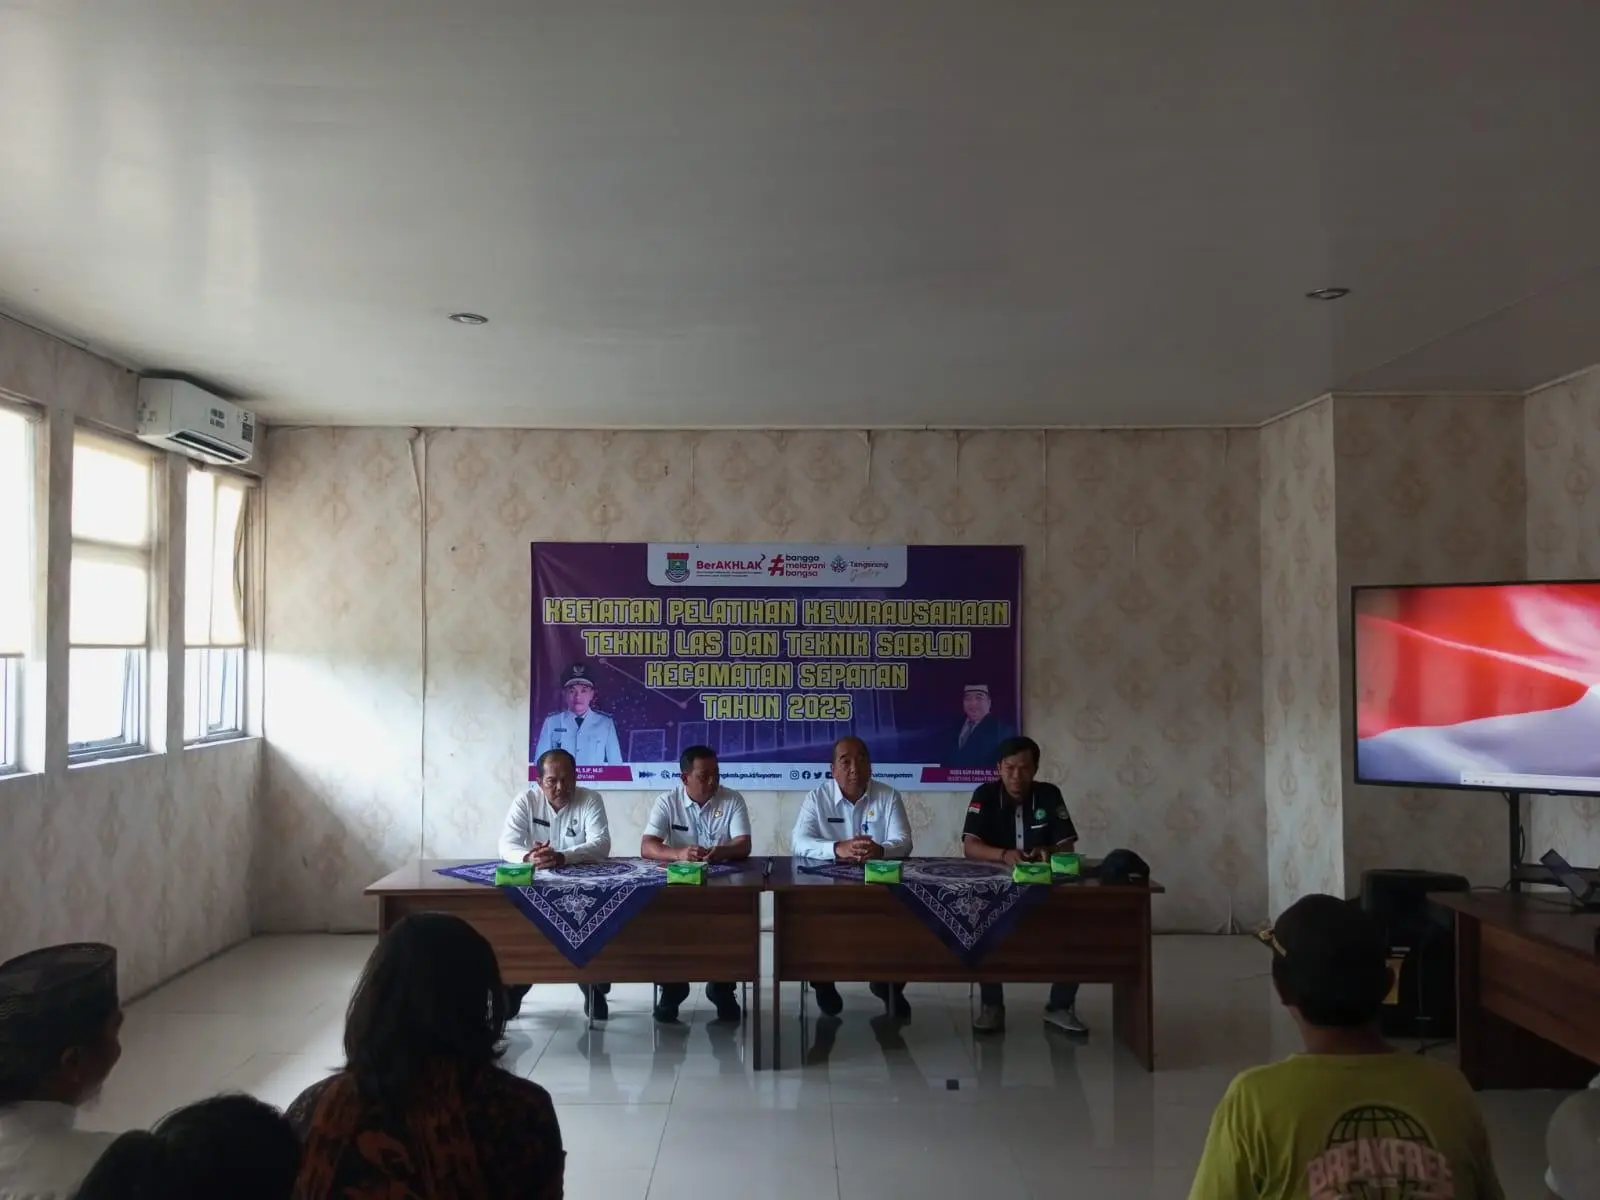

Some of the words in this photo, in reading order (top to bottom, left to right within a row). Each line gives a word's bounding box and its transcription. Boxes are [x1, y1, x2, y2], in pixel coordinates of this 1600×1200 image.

[696, 560, 763, 570] BerAKHLAK
[785, 554, 820, 563] bangga
[785, 562, 826, 570] melayani
[785, 570, 818, 578] bangsa
[544, 598, 661, 625] KEGIATAN
[667, 598, 797, 626] PELATIHAN
[802, 599, 1010, 627] KEWIRAUSAHAAN
[581, 630, 669, 656] TEKNIK
[675, 630, 723, 656] LAS
[728, 630, 778, 656] DAN
[784, 631, 870, 657] TEKNIK
[876, 632, 970, 658] SABLON
[645, 661, 793, 688] KECAMATAN
[798, 662, 907, 689] SEPATAN
[701, 694, 780, 720] TAHUN
[787, 694, 852, 720] 2025
